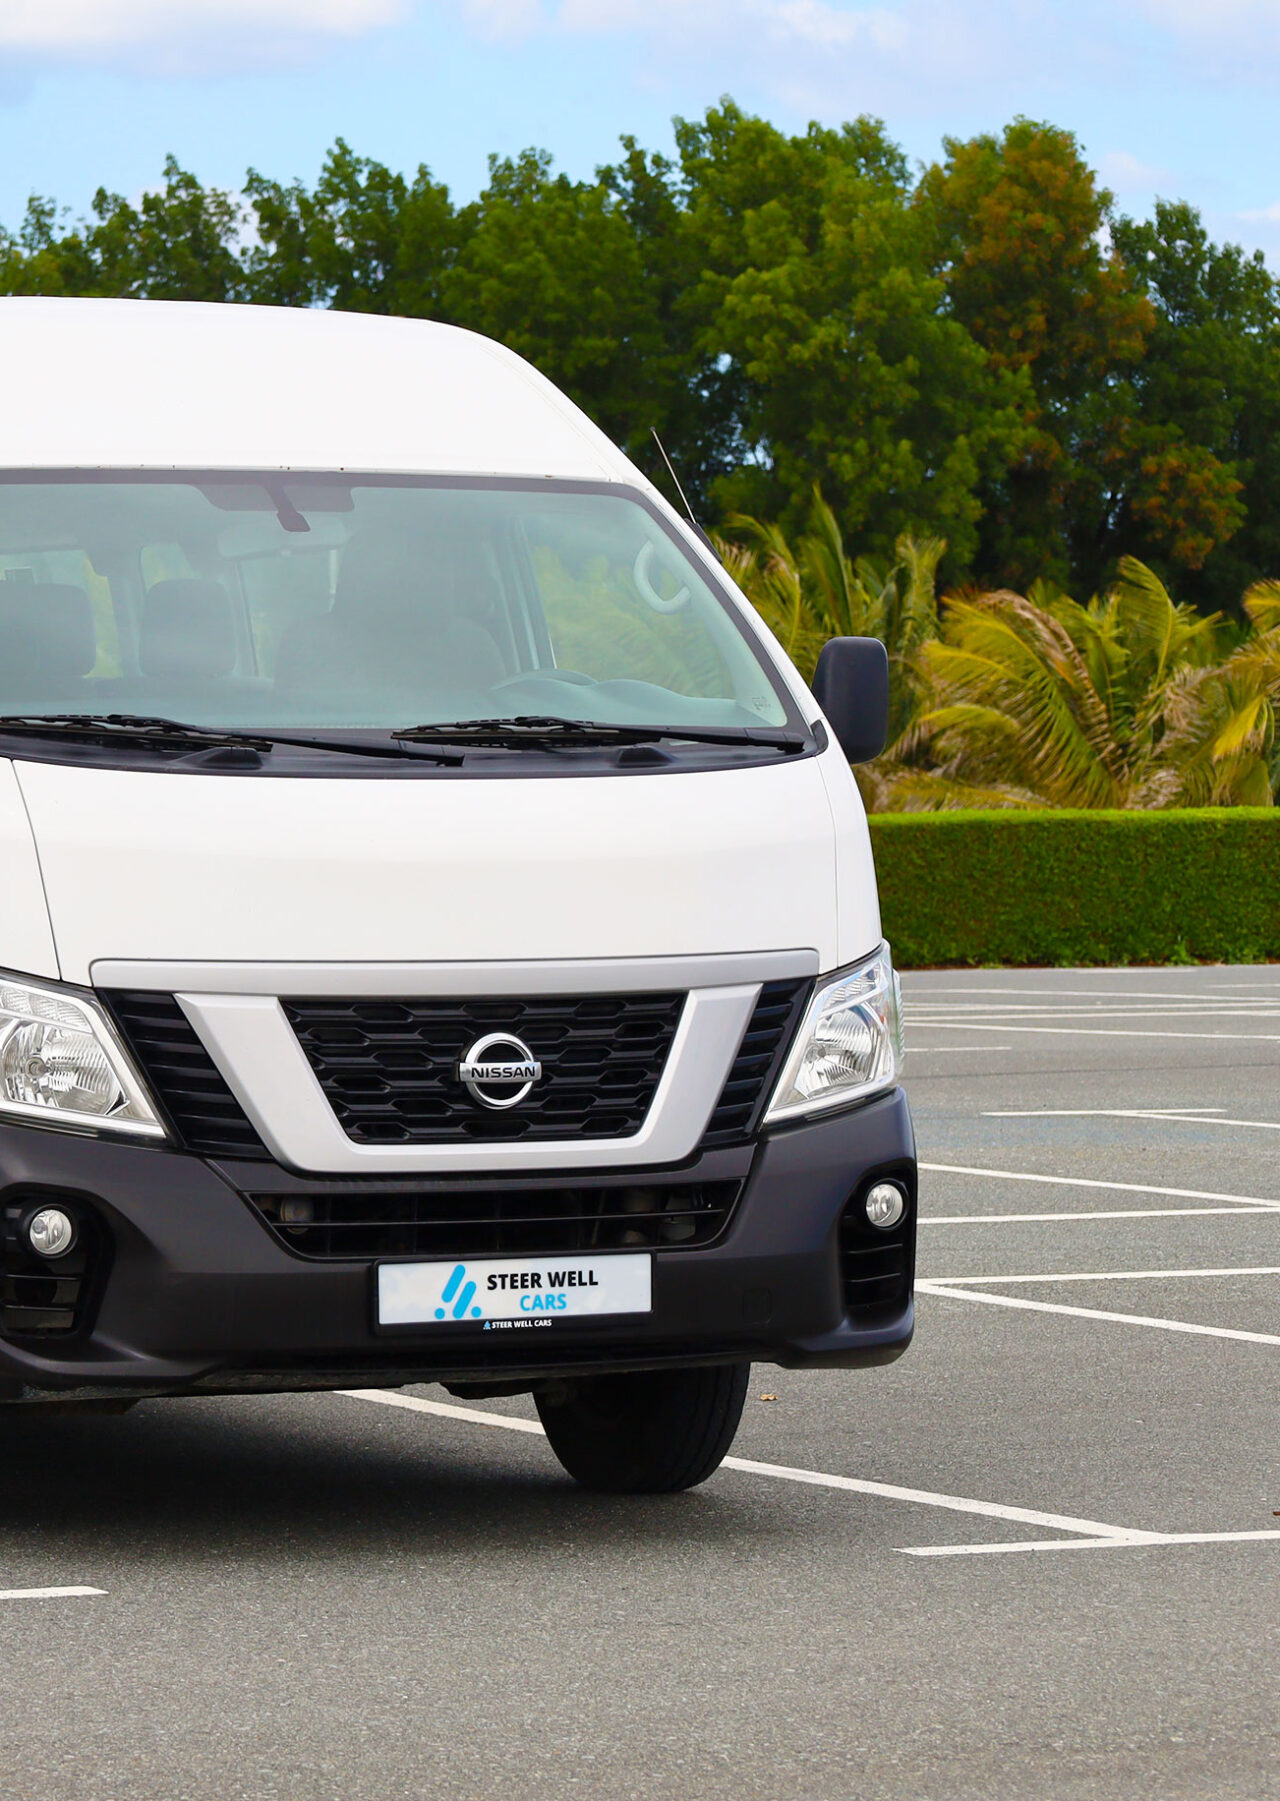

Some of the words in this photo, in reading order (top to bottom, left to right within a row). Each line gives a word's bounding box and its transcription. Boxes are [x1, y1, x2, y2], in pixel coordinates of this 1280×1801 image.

[471, 1066, 535, 1078] NISSAN
[487, 1272, 542, 1290] STEER
[548, 1270, 599, 1288] WELL
[519, 1293, 567, 1311] CARS
[491, 1321, 512, 1329] STEER
[514, 1320, 533, 1328] WELL
[534, 1319, 552, 1327] CARS
